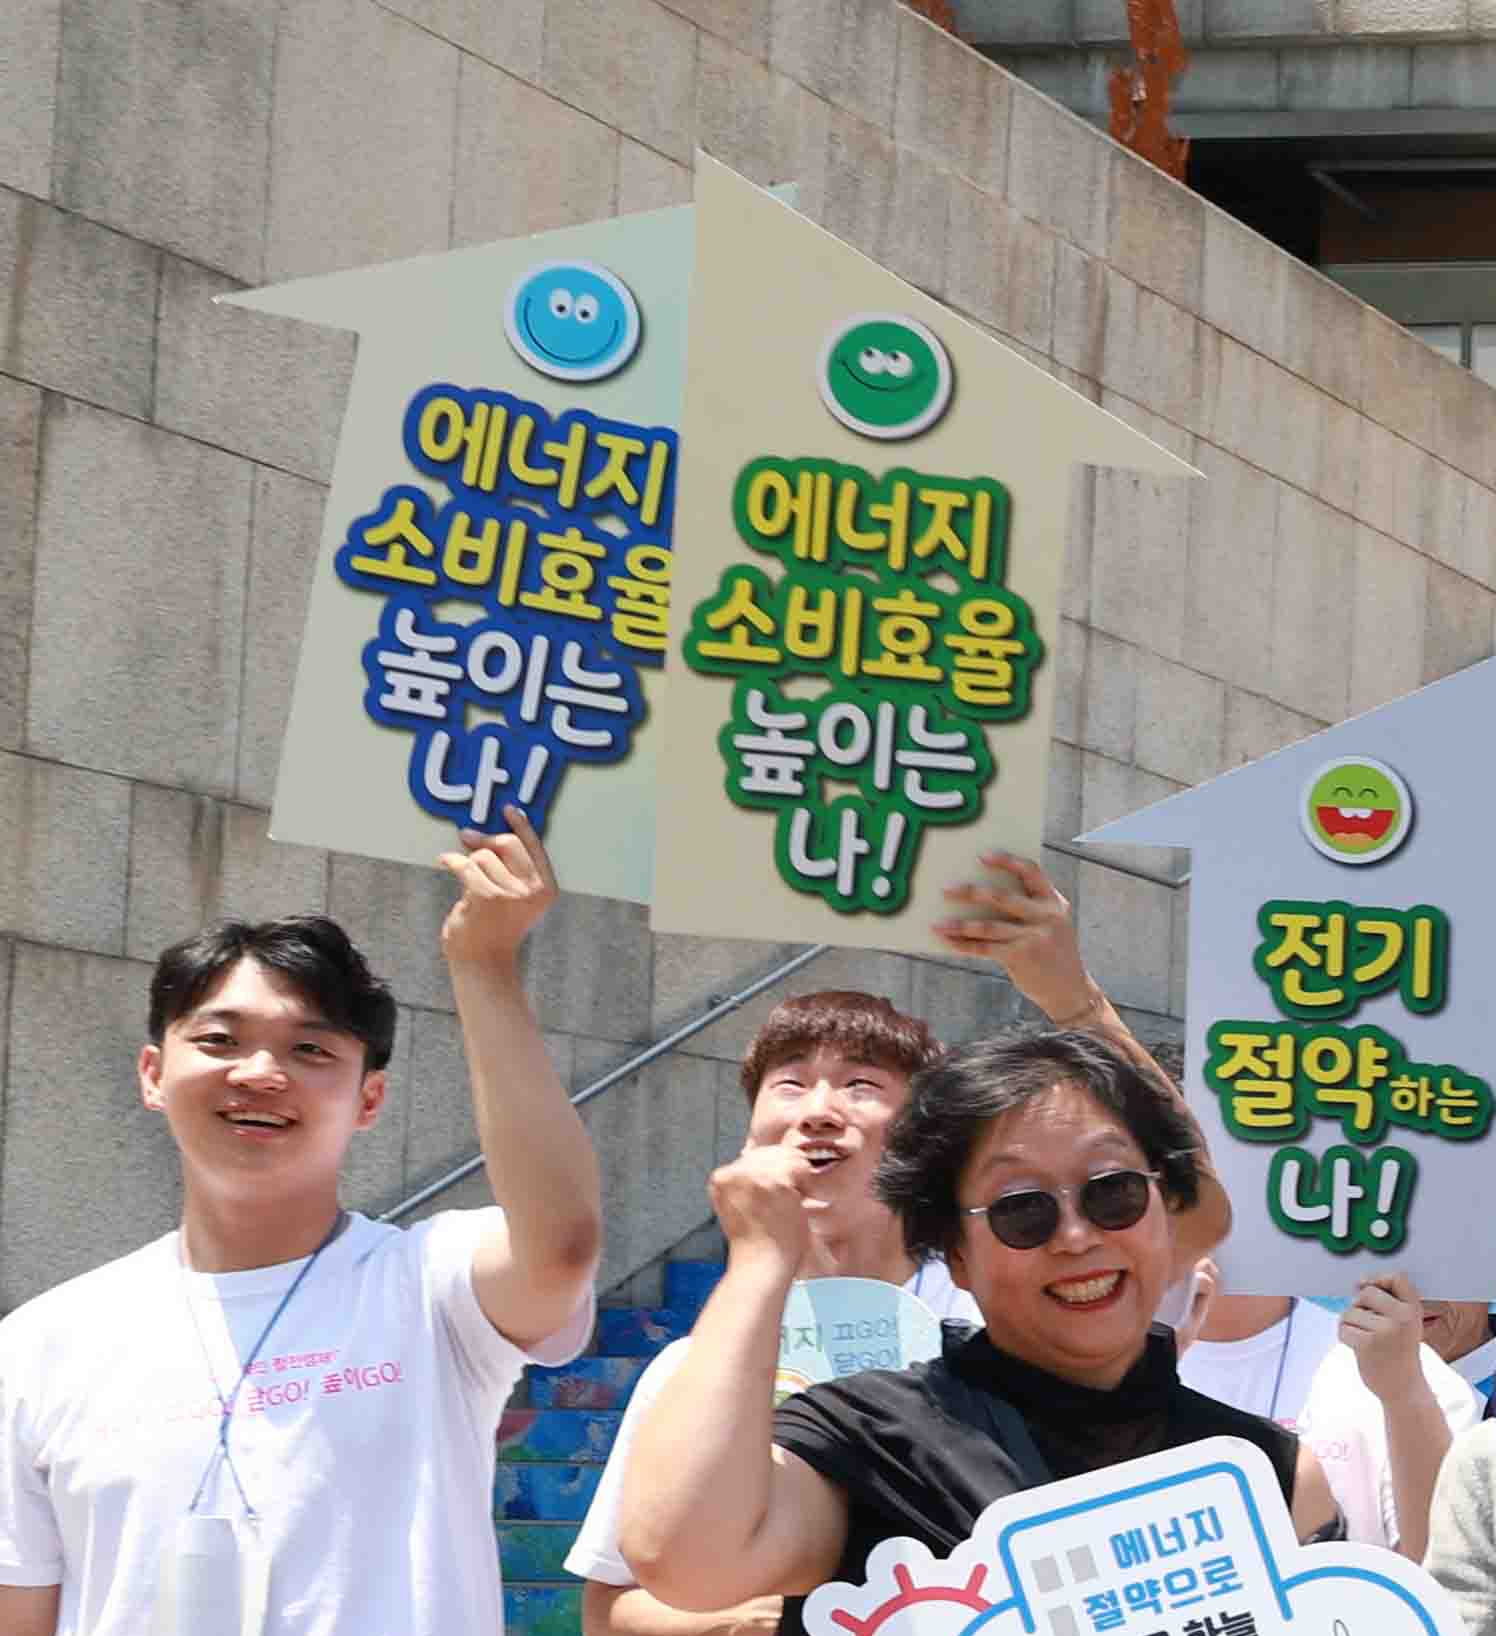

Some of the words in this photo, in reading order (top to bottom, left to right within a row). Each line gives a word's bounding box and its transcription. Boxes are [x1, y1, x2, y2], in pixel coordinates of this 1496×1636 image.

[417, 395, 670, 523] 에너지
[350, 497, 671, 649] 소비효율
[747, 468, 989, 579] 에너지
[378, 605, 630, 746] 높이는
[697, 577, 1023, 706] 소비효율
[423, 730, 548, 824] 나!
[733, 688, 975, 807] 높이는
[788, 806, 907, 896] 나!
[1266, 910, 1431, 1004] 전기
[1215, 1032, 1479, 1131] 절약하는
[1279, 1157, 1392, 1239] 나!
[1108, 1507, 1224, 1569] 에너지
[1084, 1555, 1242, 1635] 절약으로
